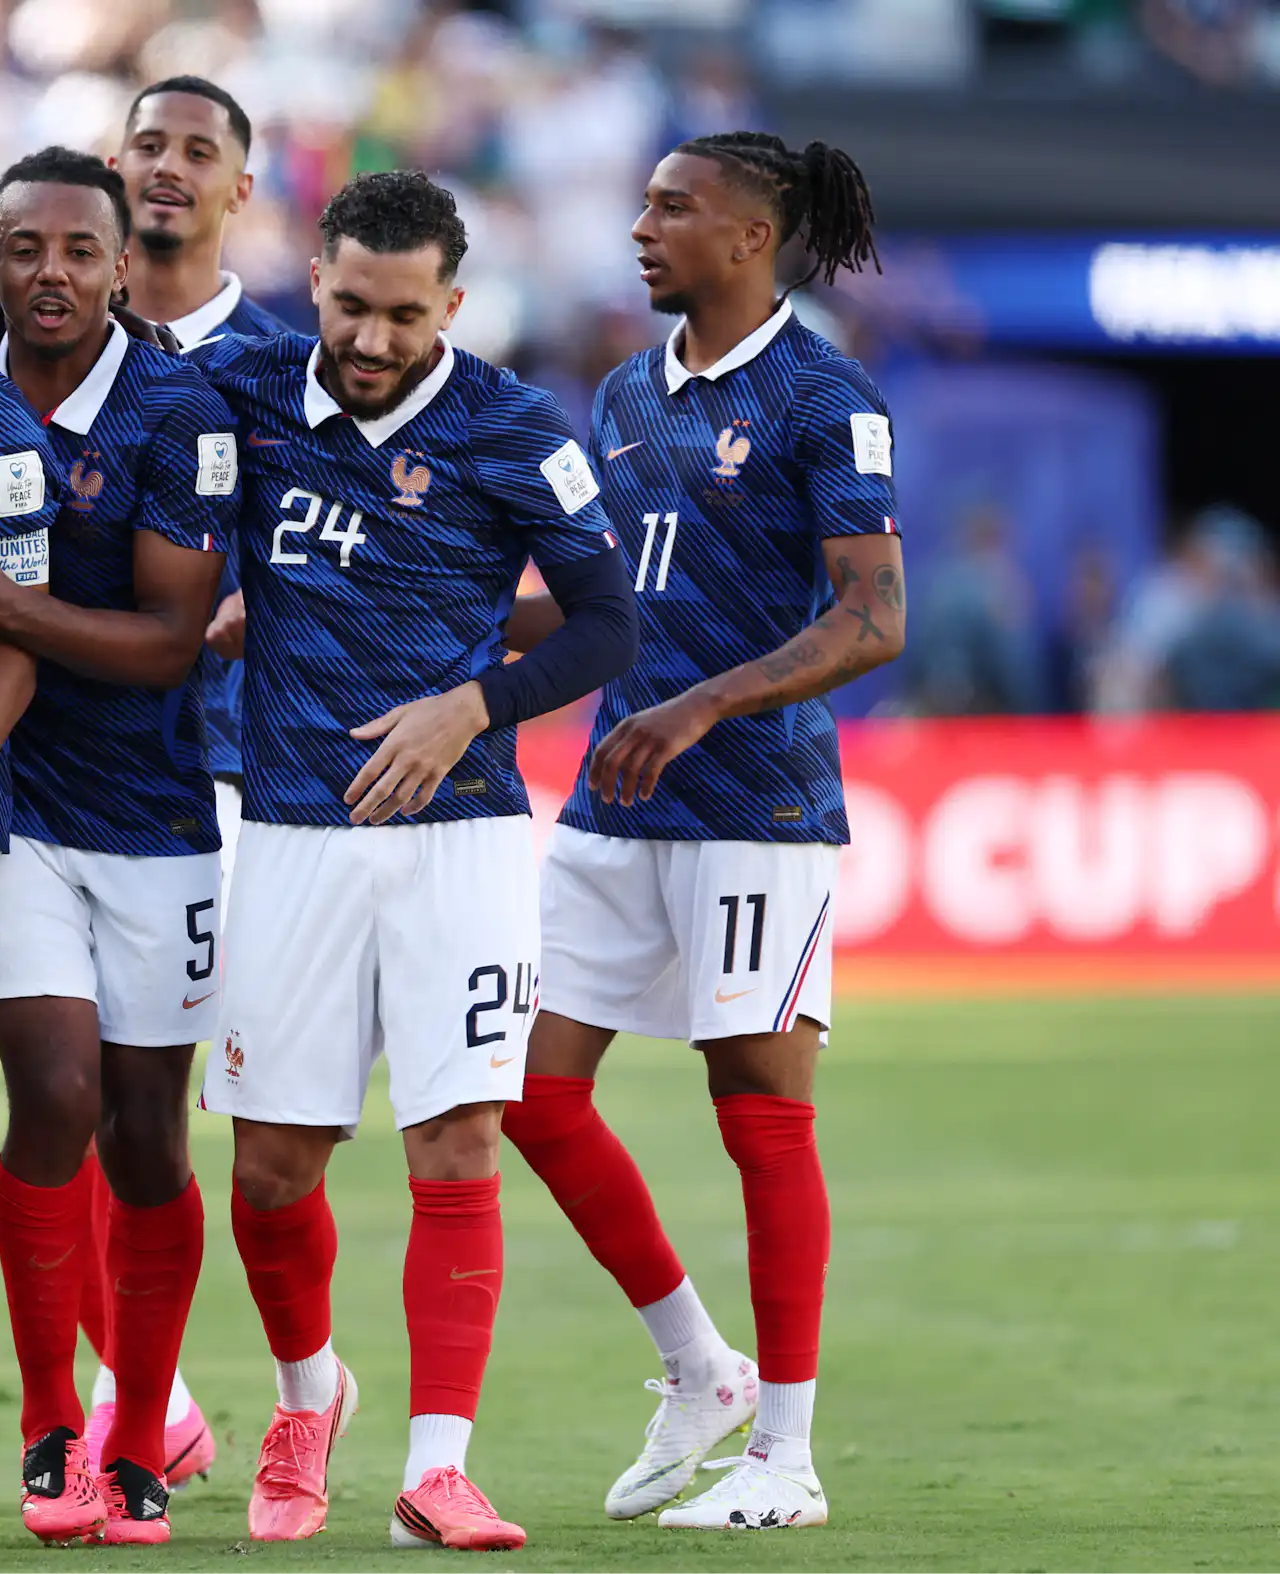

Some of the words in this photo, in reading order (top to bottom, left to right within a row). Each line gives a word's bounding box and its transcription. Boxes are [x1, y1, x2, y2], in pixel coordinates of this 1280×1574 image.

[10, 489, 32, 502] PEACE
[211, 471, 229, 481] PEACE
[0, 538, 47, 557] UNITES
[0, 558, 19, 571] the
[270, 486, 367, 568] 24
[634, 511, 679, 592] 11
[16, 571, 38, 582] FIFA
[923, 774, 1268, 945] CUP
[185, 898, 215, 982] 5
[719, 893, 767, 974] 11
[466, 962, 532, 1048] 24
